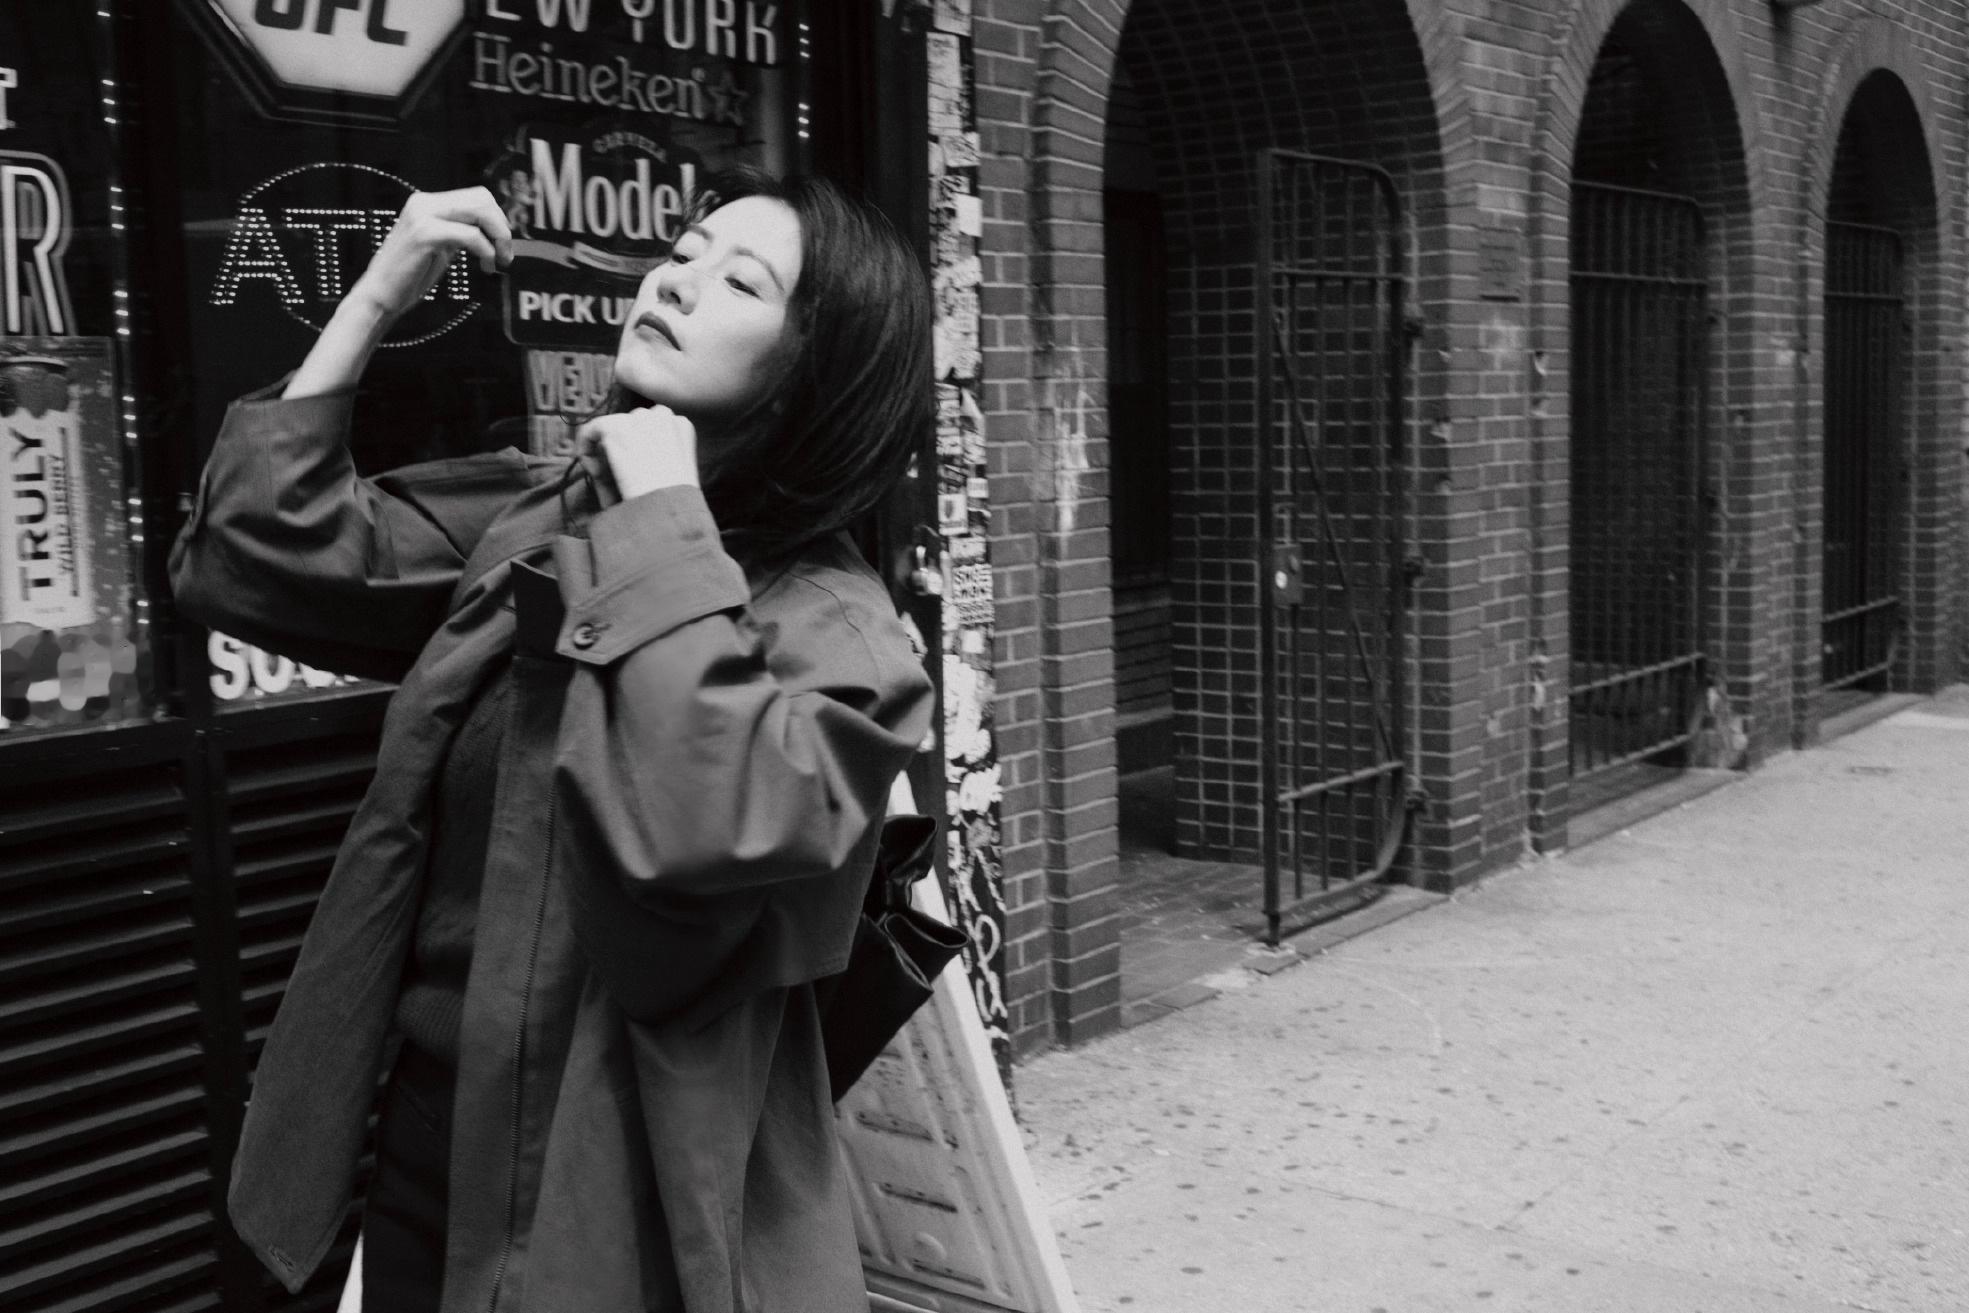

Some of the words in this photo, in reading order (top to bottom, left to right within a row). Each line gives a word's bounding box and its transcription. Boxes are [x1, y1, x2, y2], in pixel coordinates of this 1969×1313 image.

[469, 31, 706, 120] Heineken
[518, 290, 597, 324] PICK
[8, 426, 53, 600] TRULY
